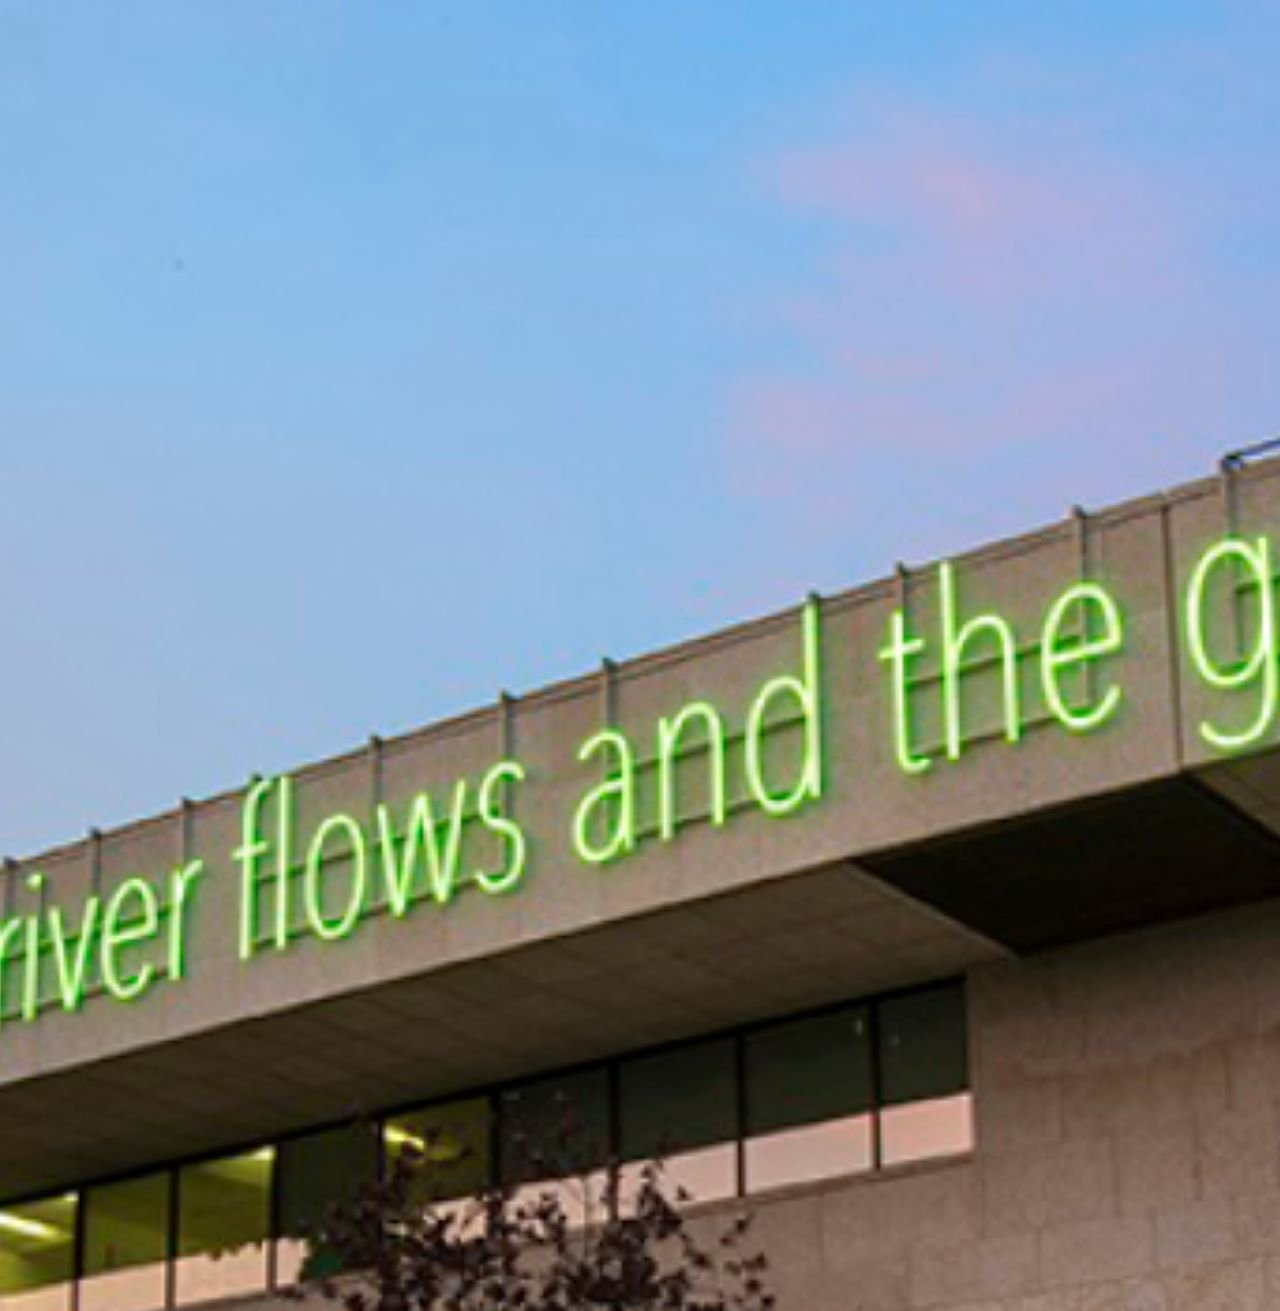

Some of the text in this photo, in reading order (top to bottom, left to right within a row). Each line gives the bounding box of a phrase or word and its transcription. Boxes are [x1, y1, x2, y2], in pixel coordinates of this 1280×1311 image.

[232, 761, 525, 959] flows
[572, 603, 822, 864] and
[879, 560, 1123, 773] the
